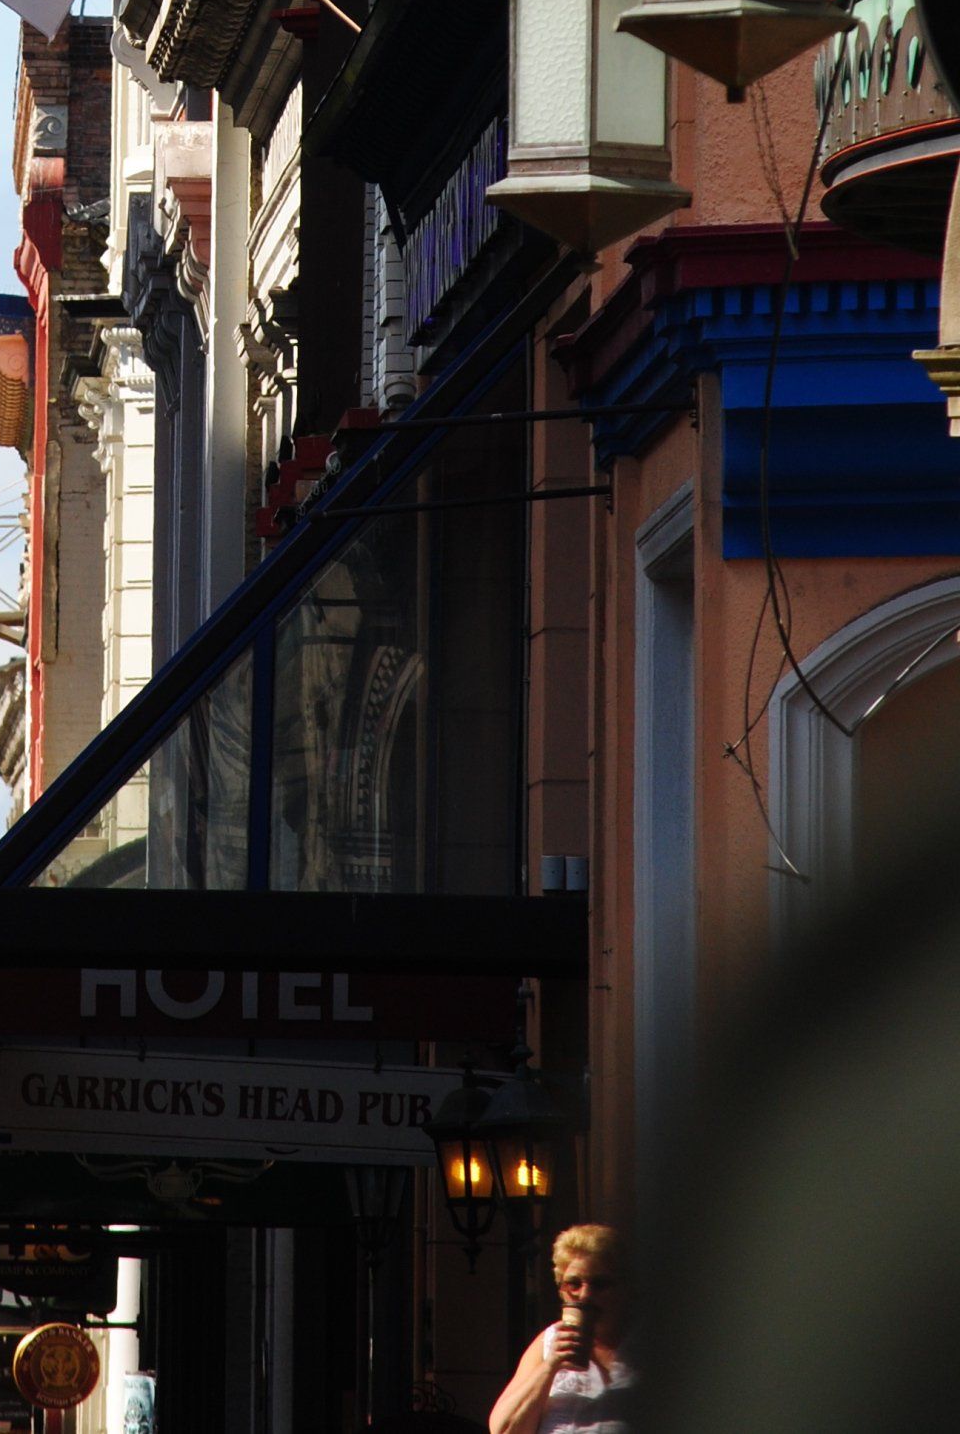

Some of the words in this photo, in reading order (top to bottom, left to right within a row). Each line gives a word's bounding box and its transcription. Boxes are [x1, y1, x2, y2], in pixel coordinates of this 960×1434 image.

[21, 1073, 226, 1117] GARRICK'S
[238, 1084, 344, 1124] HEAD
[357, 1090, 433, 1128] PUB
